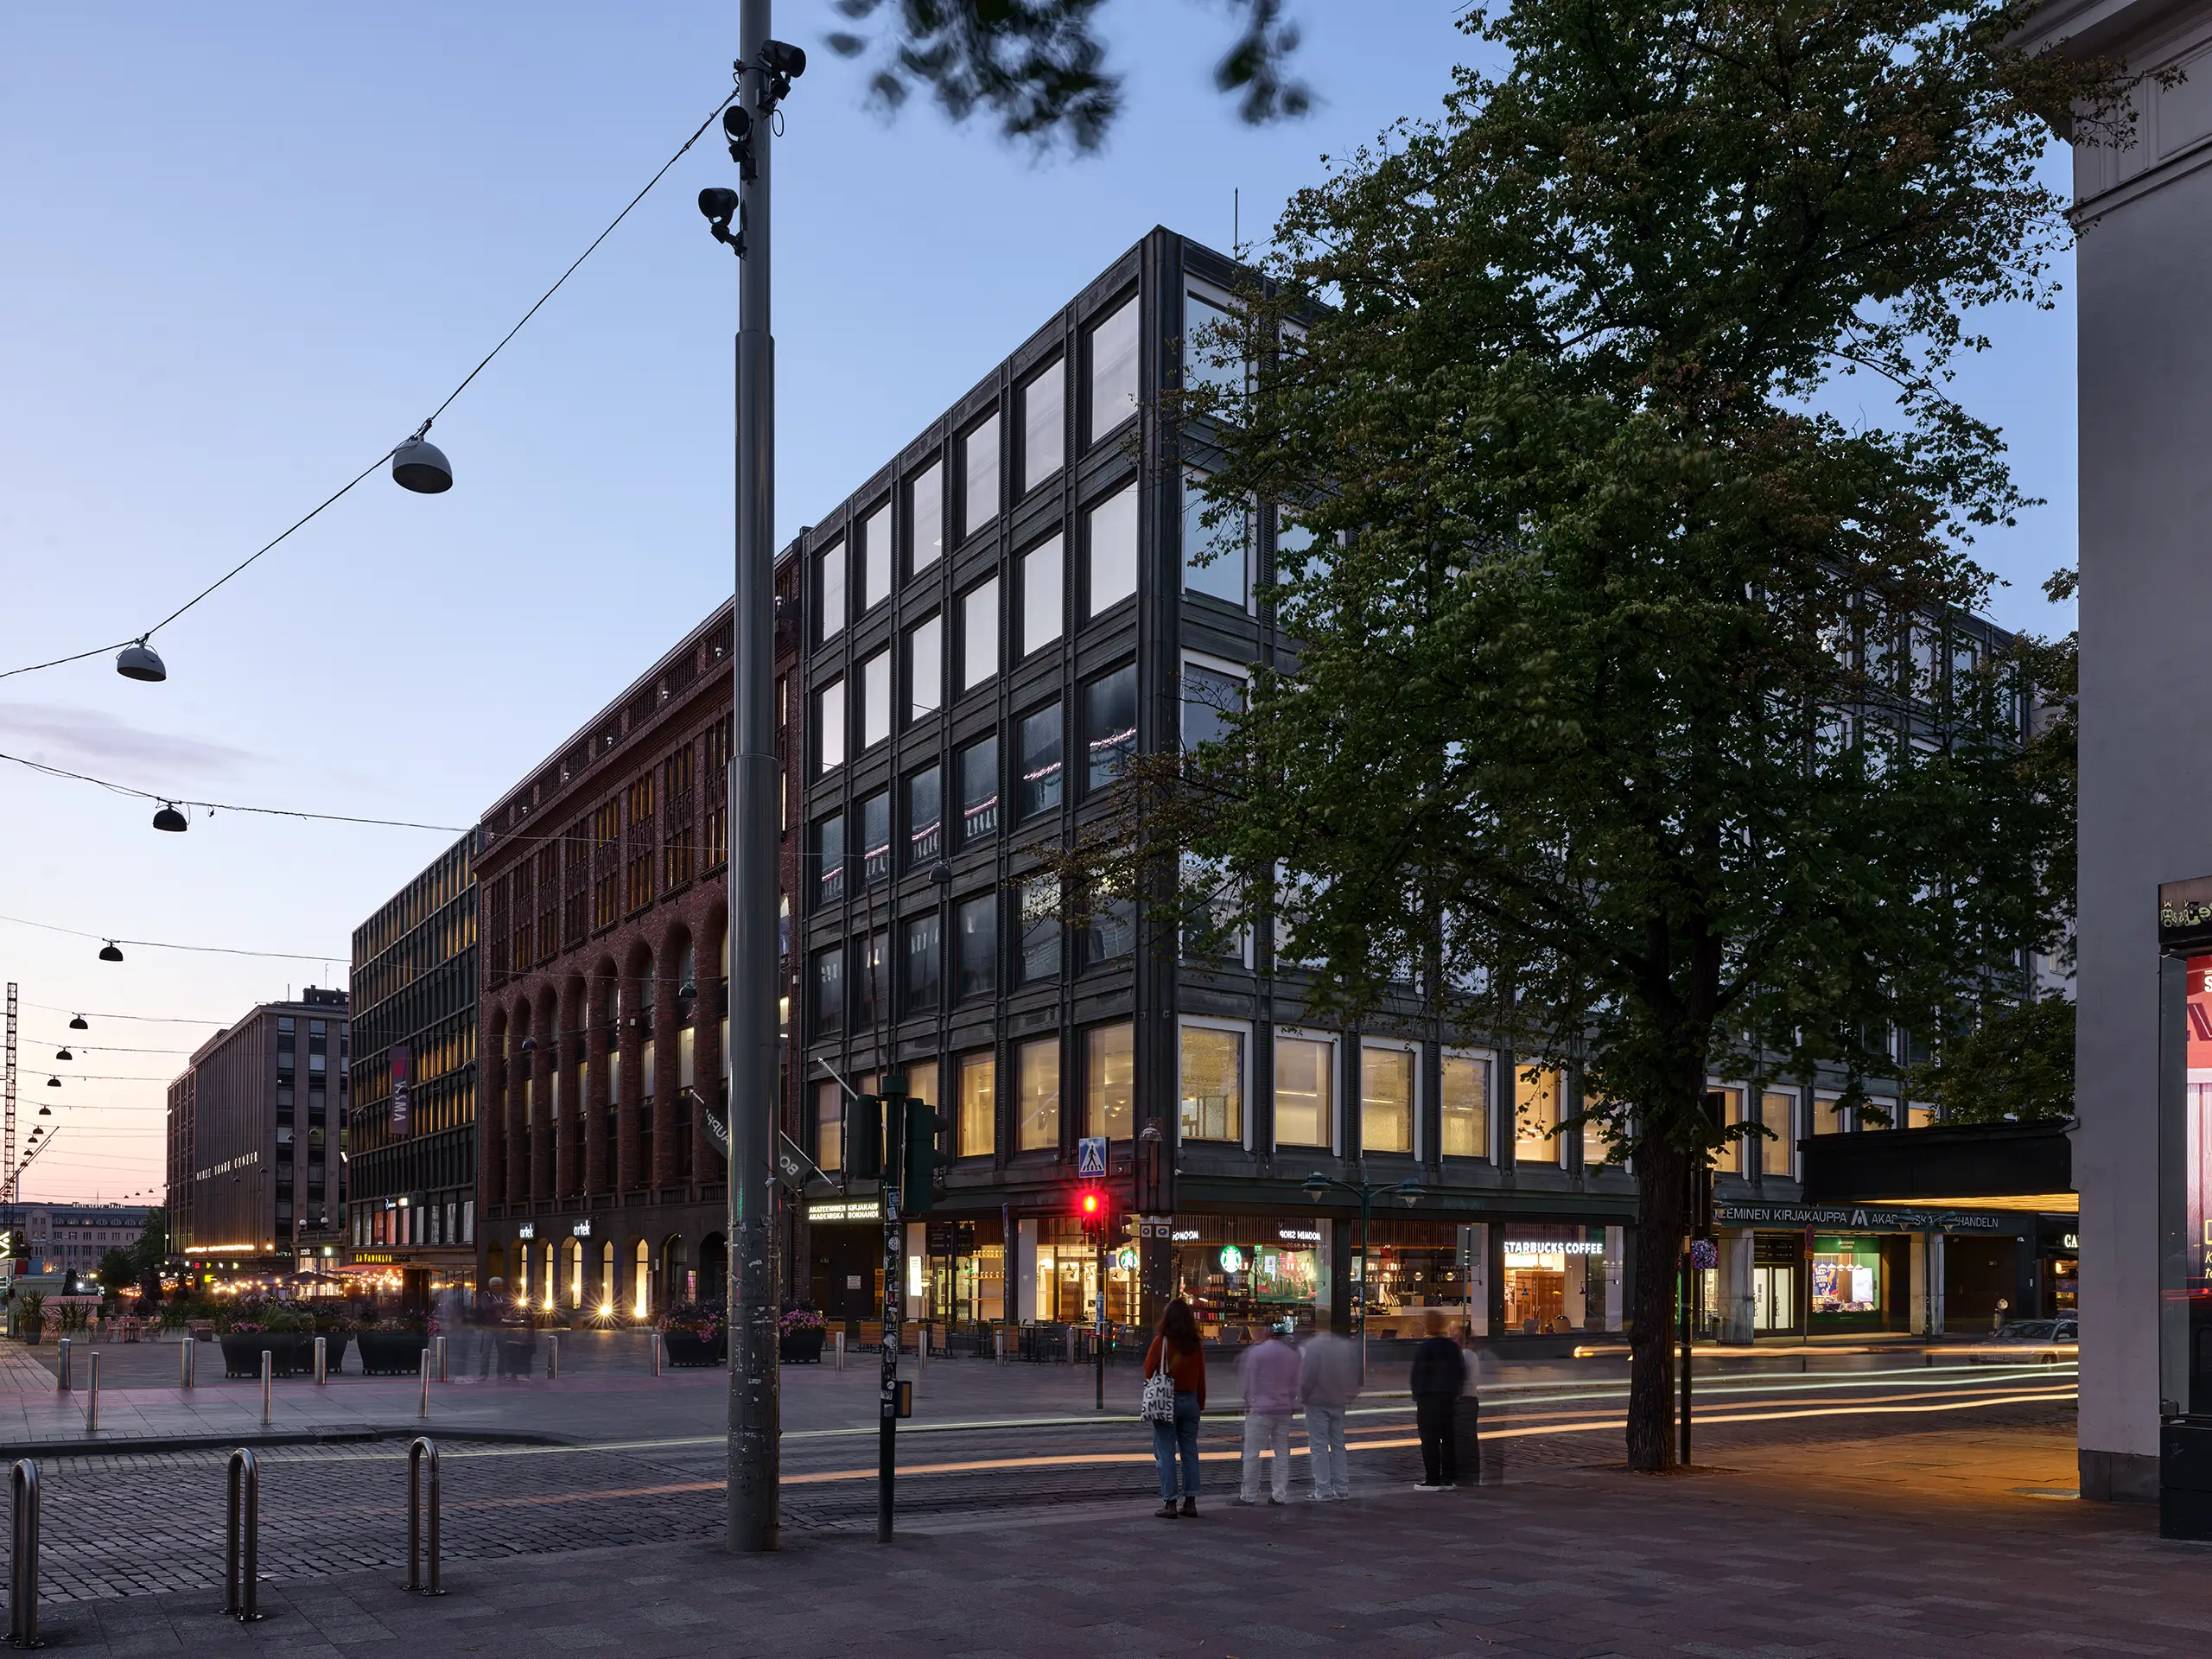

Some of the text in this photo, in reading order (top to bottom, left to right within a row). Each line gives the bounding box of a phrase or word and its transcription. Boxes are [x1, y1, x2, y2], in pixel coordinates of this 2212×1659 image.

[809, 1205, 846, 1213] AKATEEMINEN
[1774, 1210, 1847, 1223] KIRJAKAUPPA
[520, 1224, 534, 1238] artek
[574, 1219, 590, 1236] artek
[2064, 1234, 2079, 1248] CA
[1504, 1242, 1603, 1254] STARBUCKS COFFEE
